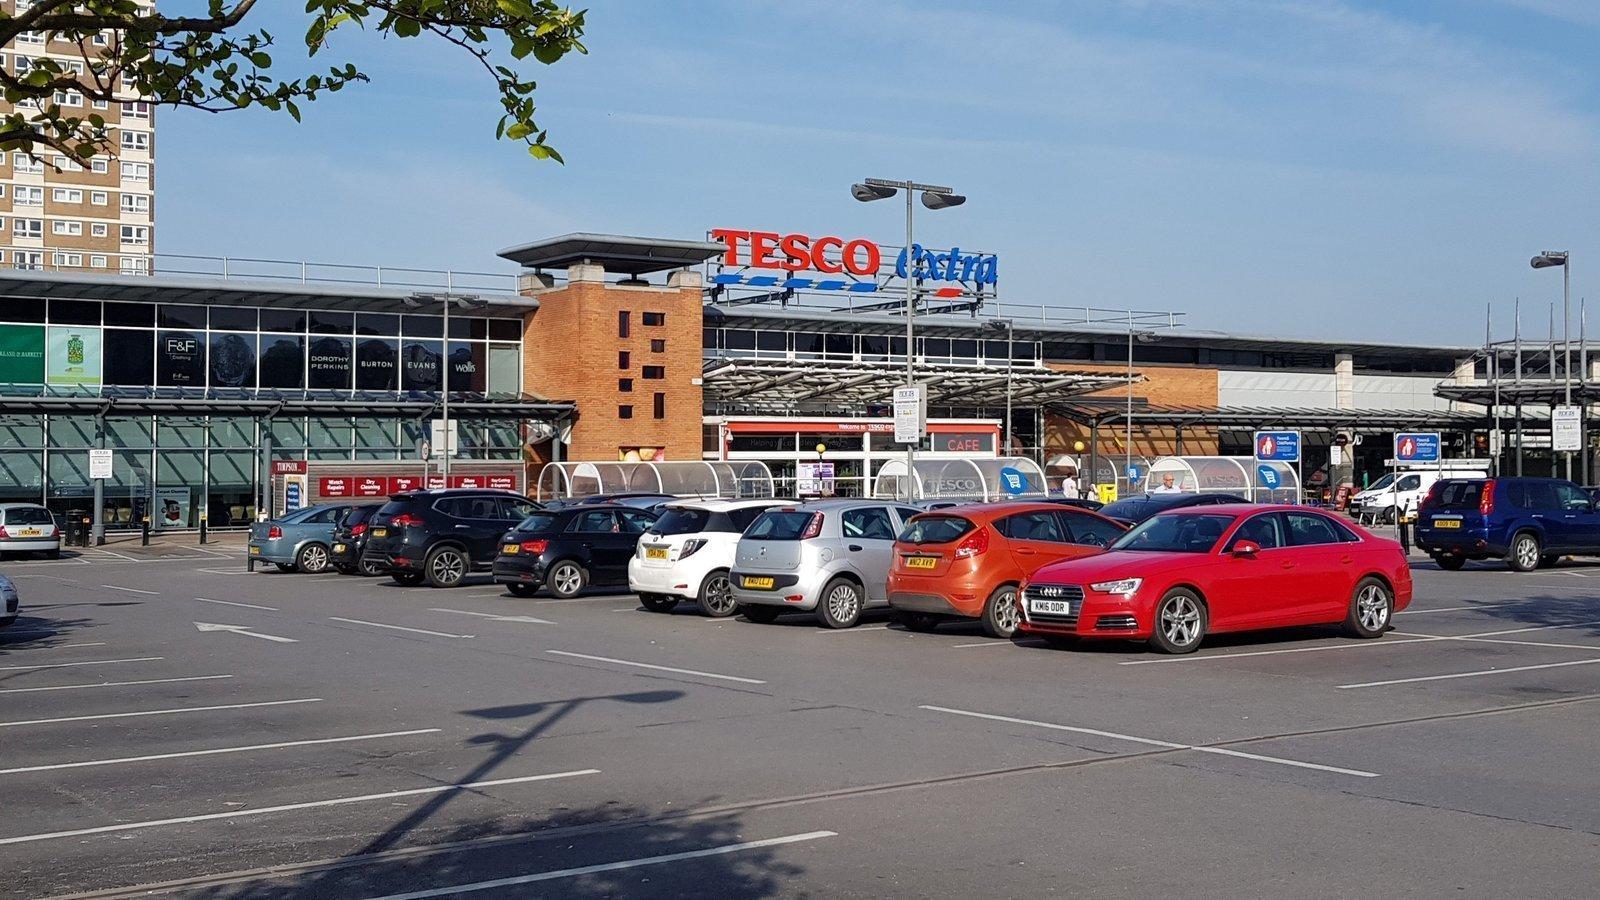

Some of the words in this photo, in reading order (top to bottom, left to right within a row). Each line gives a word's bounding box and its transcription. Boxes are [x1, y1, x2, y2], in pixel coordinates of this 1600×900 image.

[711, 228, 881, 275] TESCO
[896, 243, 998, 284] extra
[168, 339, 196, 353] F&F
[407, 361, 436, 369] EVANS
[947, 439, 980, 450] CAFE
[1352, 433, 1363, 446] JD
[277, 462, 298, 472] TIMPSON
[927, 479, 976, 490] TESCO
[1035, 601, 1050, 611] KM16
